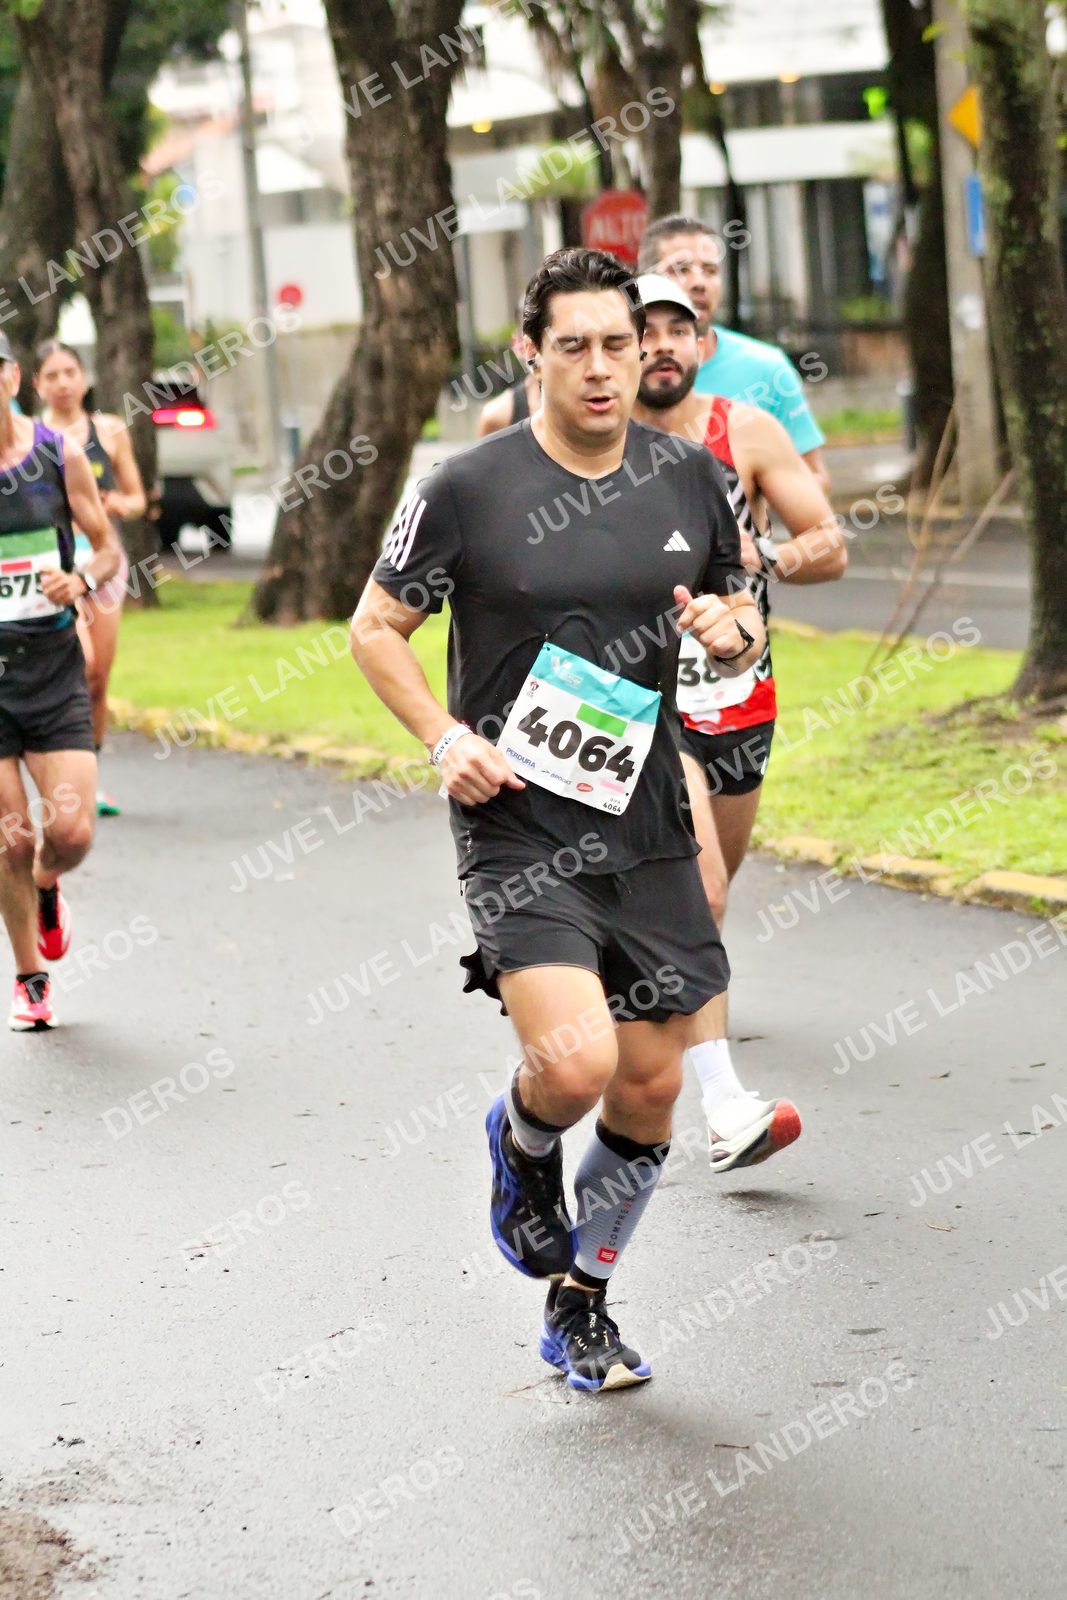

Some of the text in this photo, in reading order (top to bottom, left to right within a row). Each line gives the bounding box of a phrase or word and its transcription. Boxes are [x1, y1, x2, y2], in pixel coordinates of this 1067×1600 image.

[517, 706, 635, 783] 4064
[506, 747, 537, 769] PERDURA
[602, 802, 621, 813] 4064
